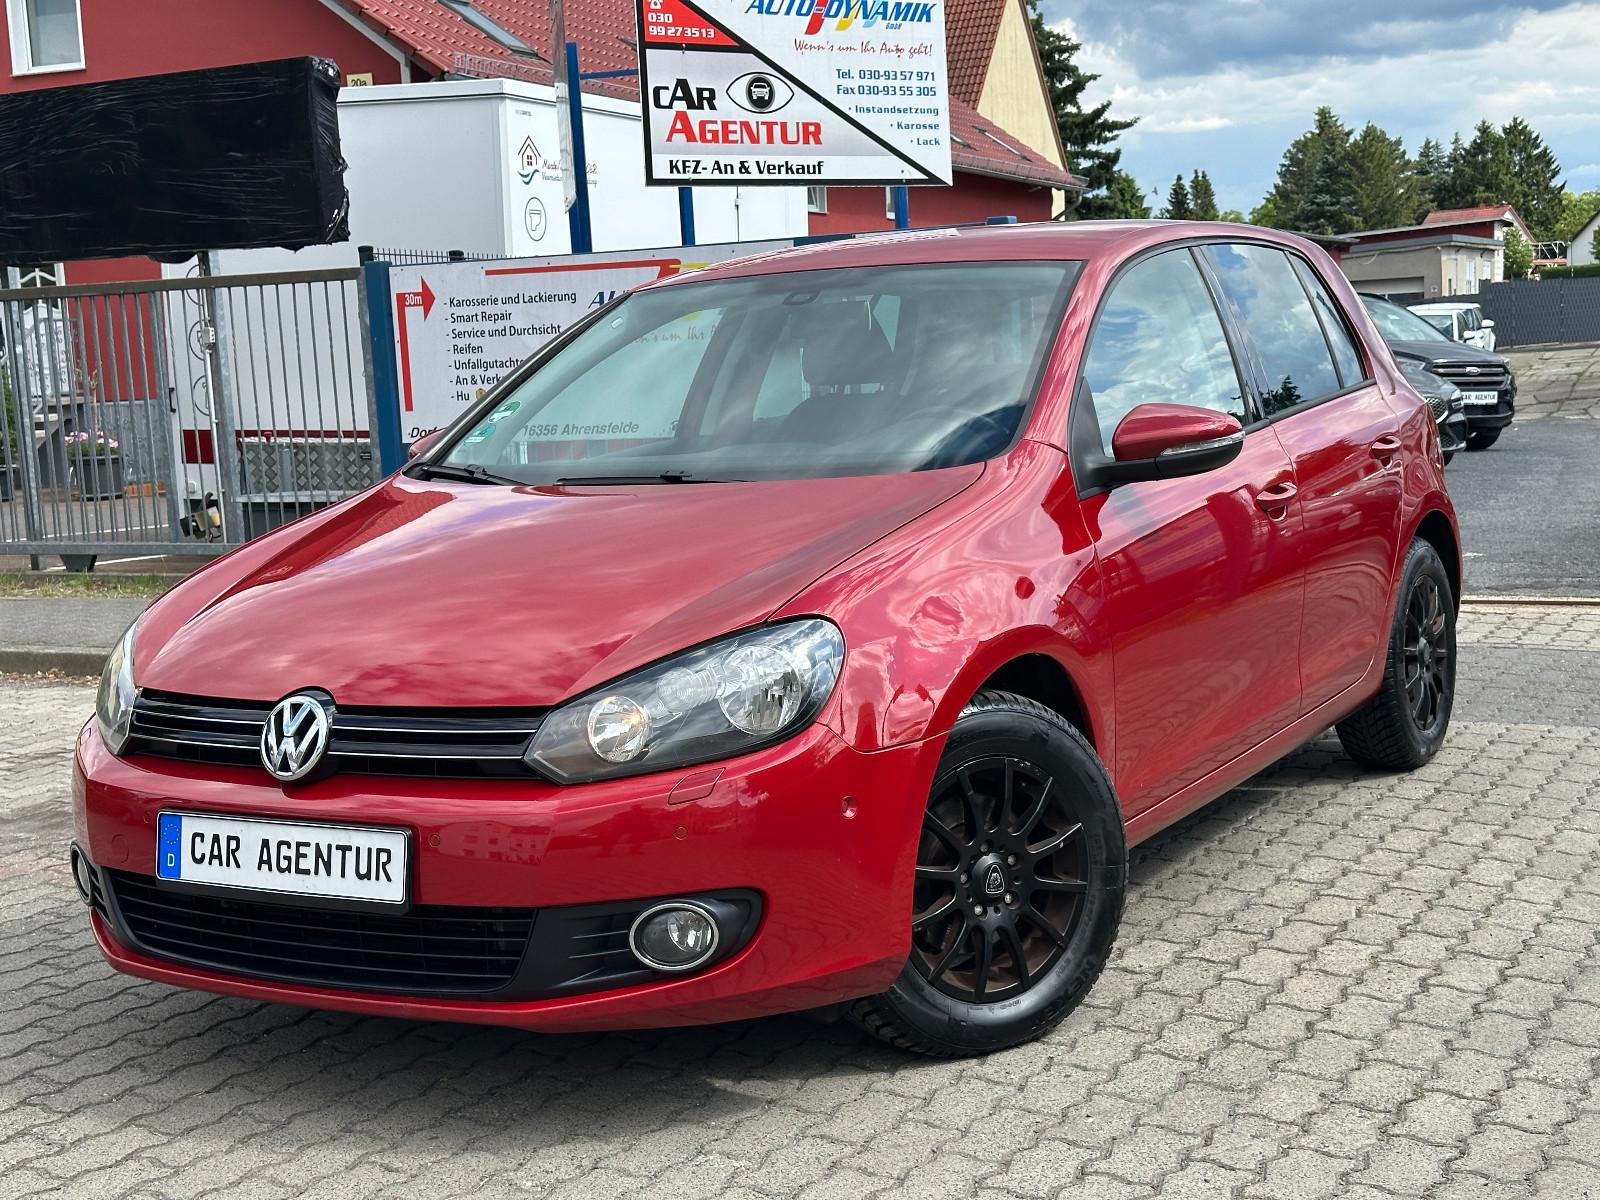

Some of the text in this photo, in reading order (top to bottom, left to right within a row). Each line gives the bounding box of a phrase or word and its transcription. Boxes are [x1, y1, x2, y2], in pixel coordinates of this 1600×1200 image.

[647, 12, 673, 23] 030
[885, 22, 903, 30] GmbH
[794, 38, 834, 52] Wenn's
[836, 45, 857, 53] um
[880, 44, 905, 55] Auto
[908, 43, 933, 59] geht!
[836, 68, 935, 82] Tel. 030-93 57 971
[836, 84, 937, 97] Fax 030-93 55 305
[855, 104, 939, 117] Instandsetzung
[665, 110, 823, 145] AGENTUR
[896, 121, 940, 130] Karosse
[916, 137, 941, 146] Lack
[669, 159, 824, 175] KFZ- An & Verkauf
[404, 293, 422, 306] 30m
[449, 294, 499, 308] Karosserie
[500, 293, 520, 306] und
[522, 291, 577, 304] Lackierung
[450, 310, 513, 324] Smart Repair
[451, 323, 562, 340] Service und Durchsicht
[452, 343, 484, 355] Reifen
[455, 373, 506, 386] An & Verk
[456, 390, 470, 401] Hu
[523, 422, 640, 437] 16356 Ahrensfelde
[167, 852, 176, 868] D
[190, 831, 393, 883] CAR AGENTUR
